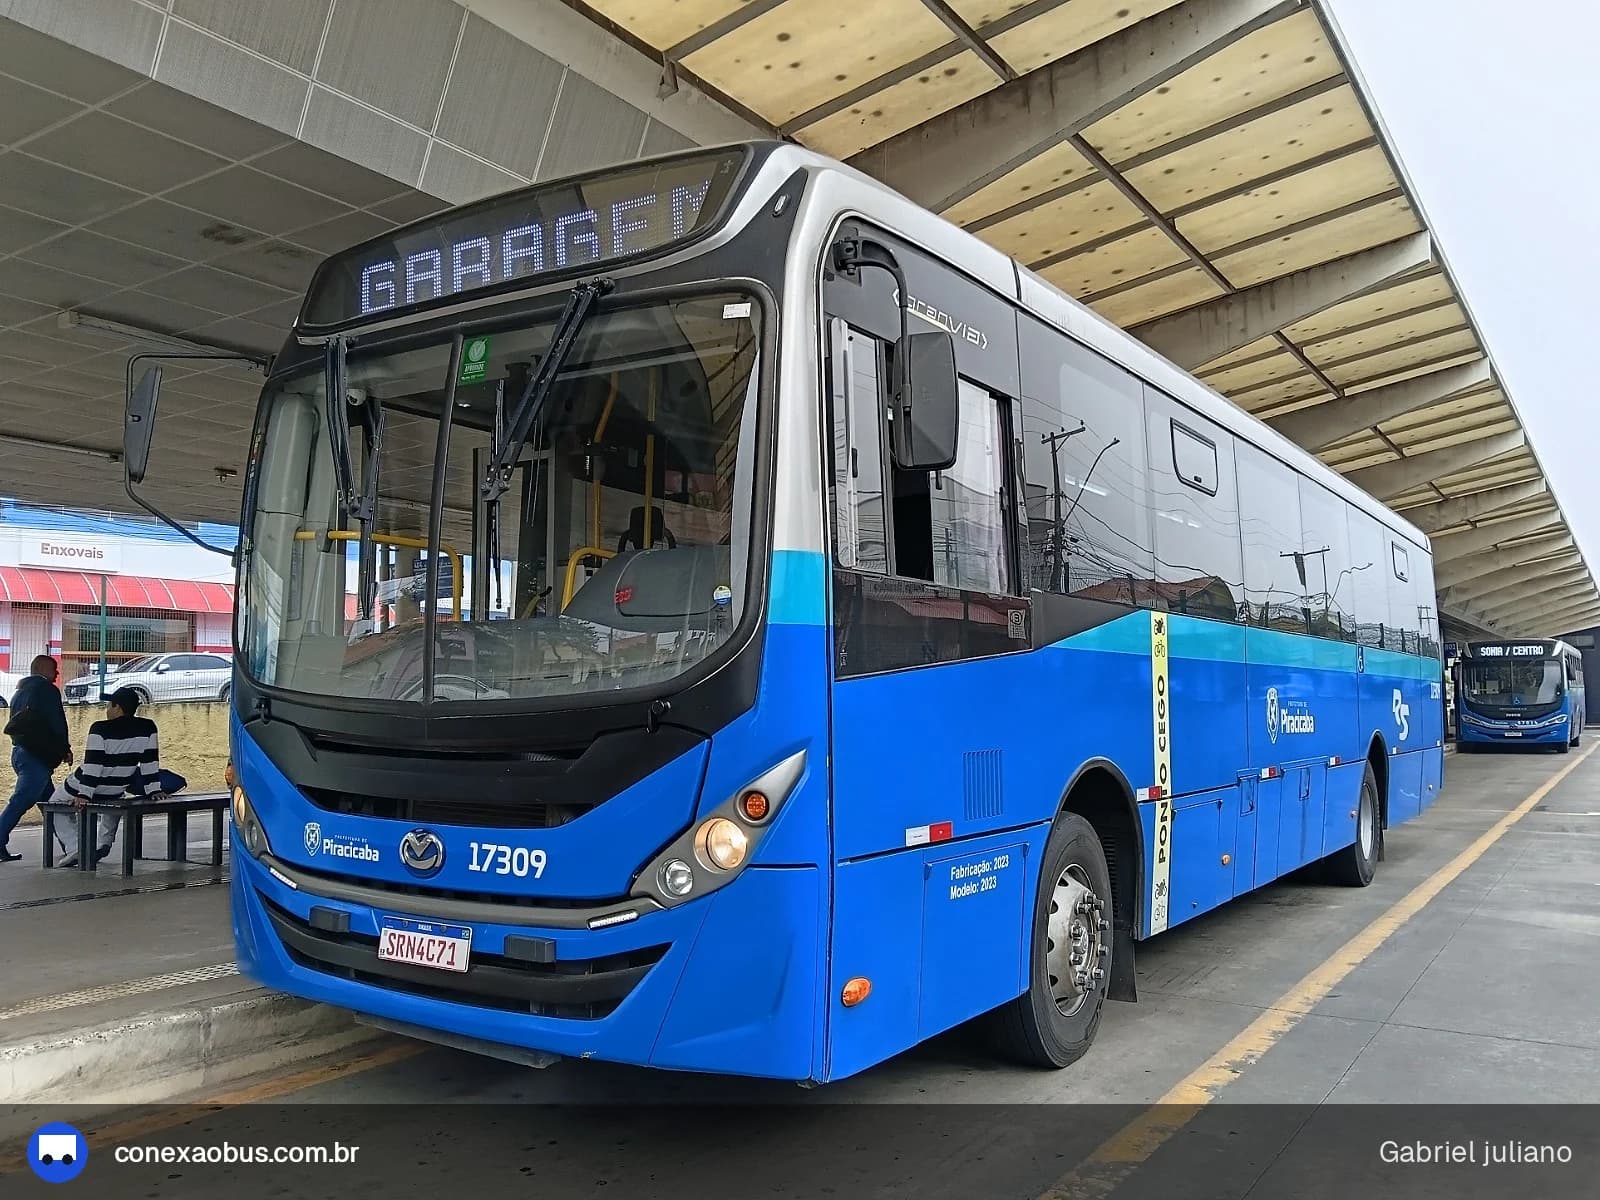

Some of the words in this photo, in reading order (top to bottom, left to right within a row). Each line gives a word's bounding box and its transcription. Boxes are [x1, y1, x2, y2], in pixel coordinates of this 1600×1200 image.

[40, 541, 104, 559] Enxovais
[1512, 645, 1544, 656] CENTRO
[1157, 674, 1166, 753] CEGO
[1281, 708, 1314, 734] Piracicaba
[322, 838, 380, 862] Piracicaba
[468, 842, 547, 879] 17309
[951, 860, 992, 880] Fabricação:
[994, 855, 1009, 870] 2023
[951, 883, 979, 900] Modelo:
[981, 877, 997, 892] 2023
[386, 932, 457, 966] SRN4C71
